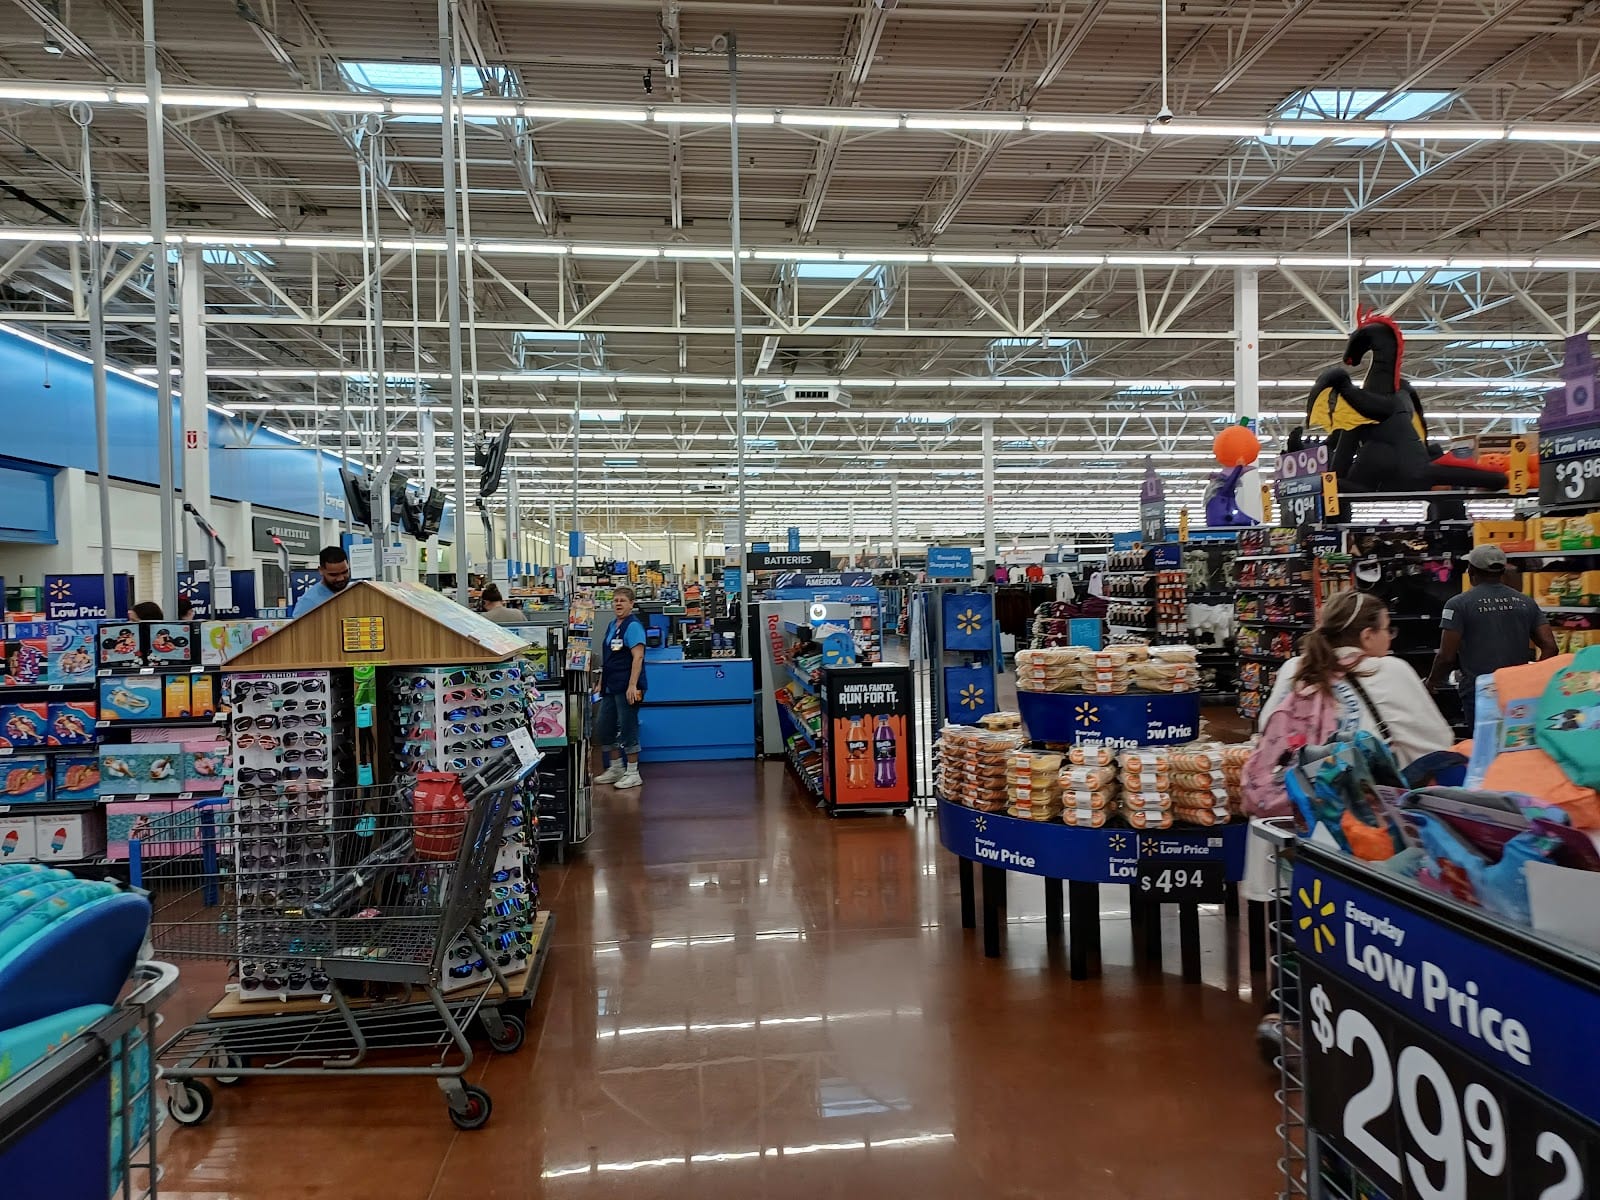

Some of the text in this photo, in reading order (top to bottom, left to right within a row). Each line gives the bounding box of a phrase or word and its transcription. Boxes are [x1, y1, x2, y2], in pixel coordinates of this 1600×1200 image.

[1554, 443, 1577, 455] Low
[1577, 437, 1600, 452] Pric
[1287, 486, 1298, 494] Low
[1298, 483, 1313, 493] Price
[764, 555, 813, 565] BATTERIES
[805, 578, 842, 586] AMERICA
[50, 606, 107, 618] Low Pric
[844, 683, 894, 692] WANTA FANTA?
[839, 692, 862, 705] RUN
[863, 692, 885, 704] FOR
[1167, 725, 1192, 739] Price
[1104, 736, 1138, 749] Price
[975, 842, 1036, 868] Low Price
[1160, 844, 1210, 855] Low Price
[1344, 900, 1406, 947] Everyday
[1344, 921, 1532, 1066] Low Price
